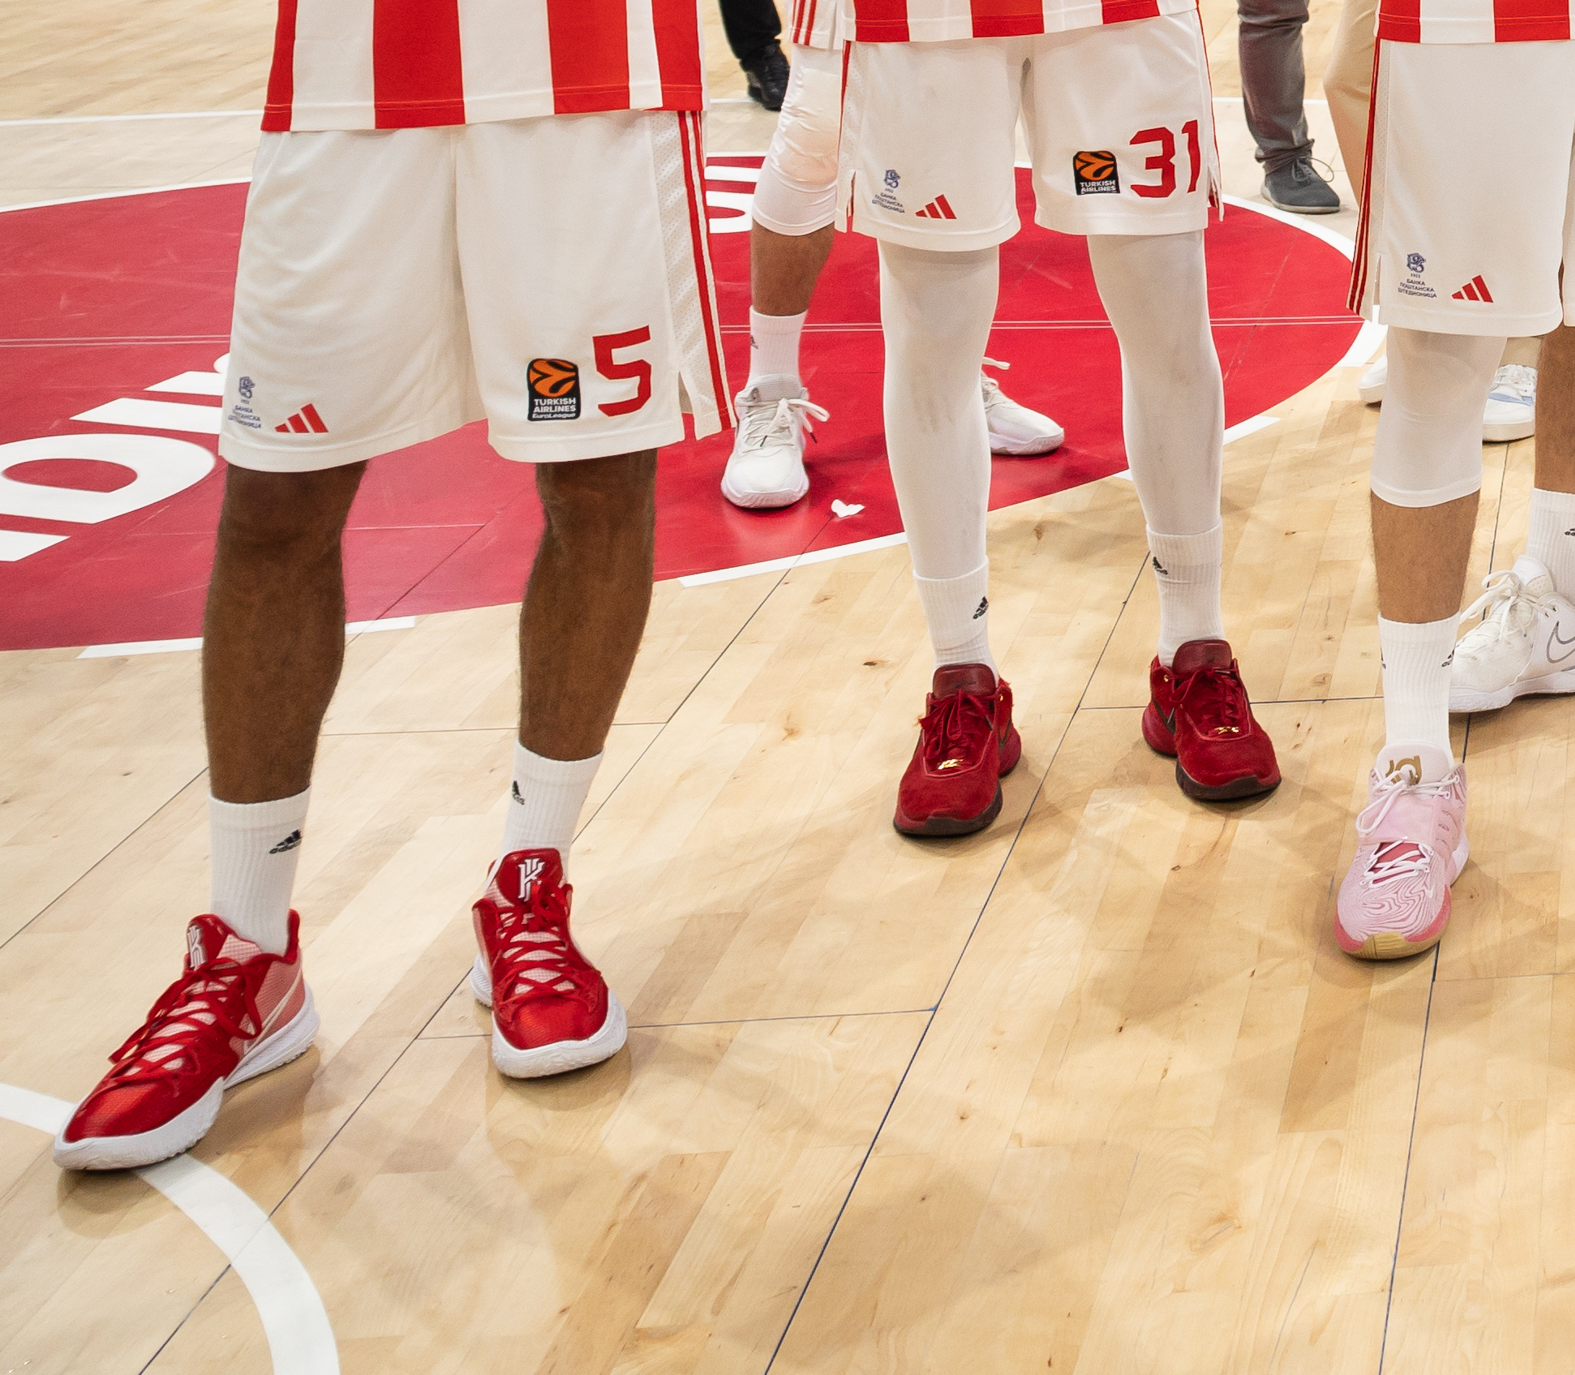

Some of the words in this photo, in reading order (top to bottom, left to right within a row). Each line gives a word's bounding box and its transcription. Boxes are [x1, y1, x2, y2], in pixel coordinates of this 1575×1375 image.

[1129, 119, 1200, 199] 31
[1080, 180, 1116, 188] TURKISH
[592, 324, 651, 418] 5
[533, 405, 576, 413] AIRLINES
